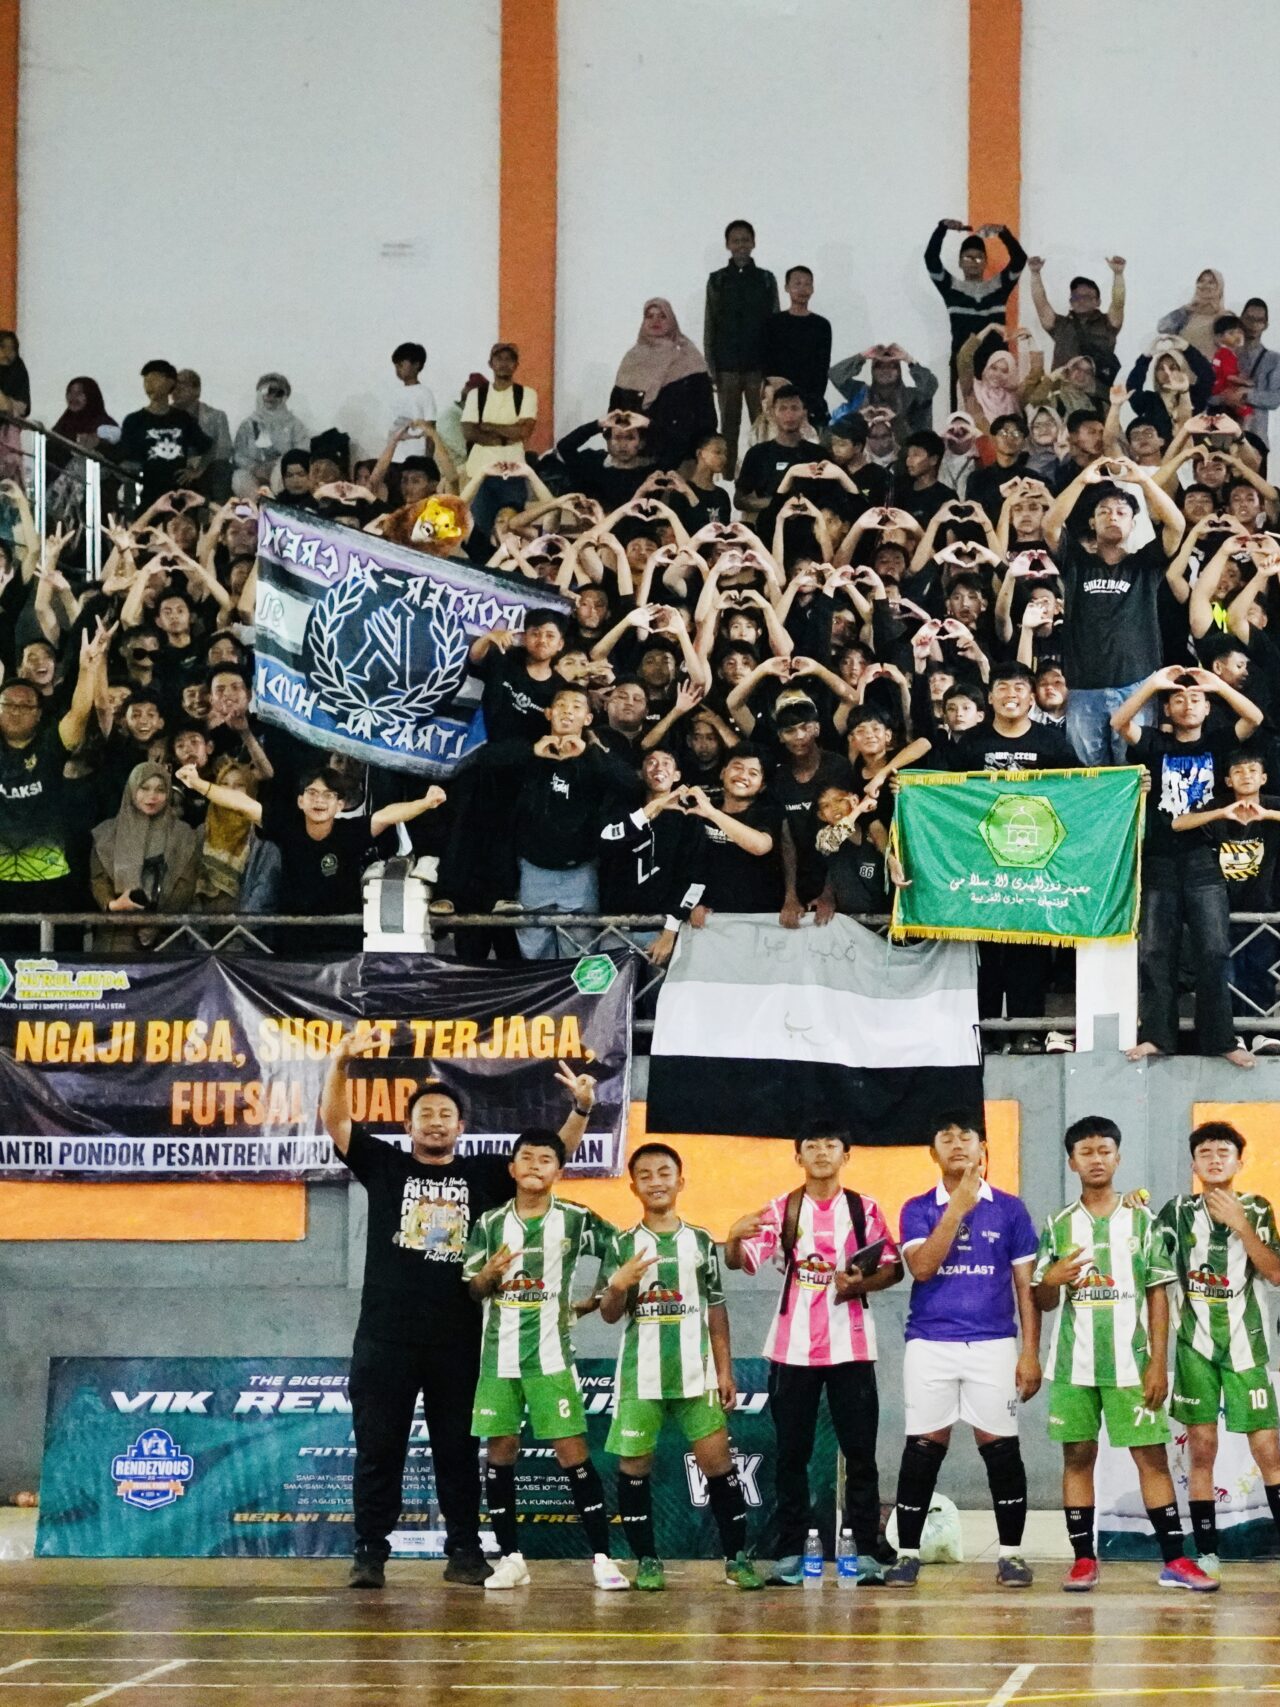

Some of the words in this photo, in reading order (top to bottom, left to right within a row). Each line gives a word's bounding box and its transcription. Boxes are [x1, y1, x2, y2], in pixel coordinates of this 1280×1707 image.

[859, 865, 875, 878] 86
[15, 1020, 136, 1063] NGAJI
[145, 1019, 246, 1067] BISA,
[410, 1015, 597, 1063] TERJAGA,
[172, 1079, 309, 1127] FUTSAL
[58, 1141, 145, 1167] PONDOK
[152, 1141, 272, 1167] PESANTREN
[250, 1375, 284, 1386] THE
[111, 1391, 214, 1413] VIK
[1248, 1388, 1268, 1410] 10
[115, 1460, 189, 1476] RENDEZVOUS
[233, 1512, 319, 1523] BERANI
